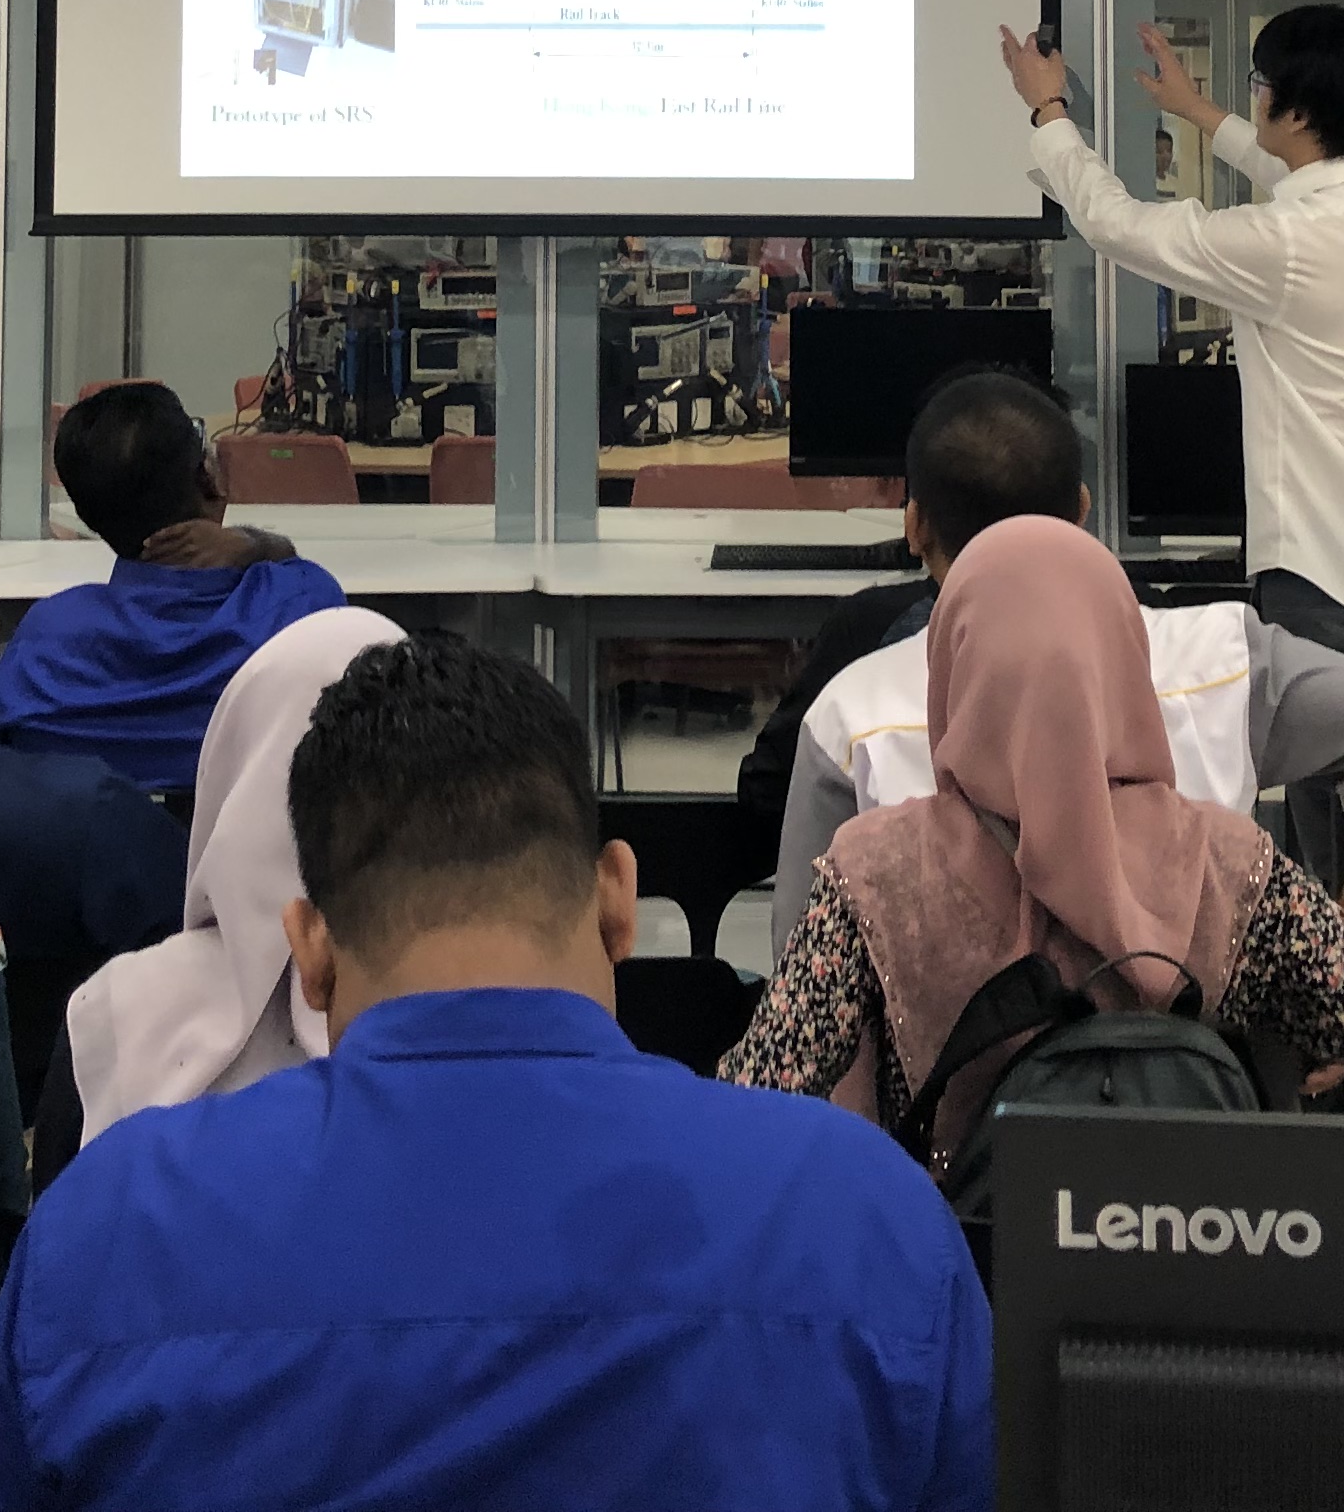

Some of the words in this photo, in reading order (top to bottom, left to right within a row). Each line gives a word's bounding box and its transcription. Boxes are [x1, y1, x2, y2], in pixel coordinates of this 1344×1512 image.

[211, 105, 303, 126] Prototype
[309, 105, 327, 122] of
[334, 104, 375, 123] SRS
[704, 97, 741, 114] Rail
[1057, 1188, 1322, 1258] Lenovo
